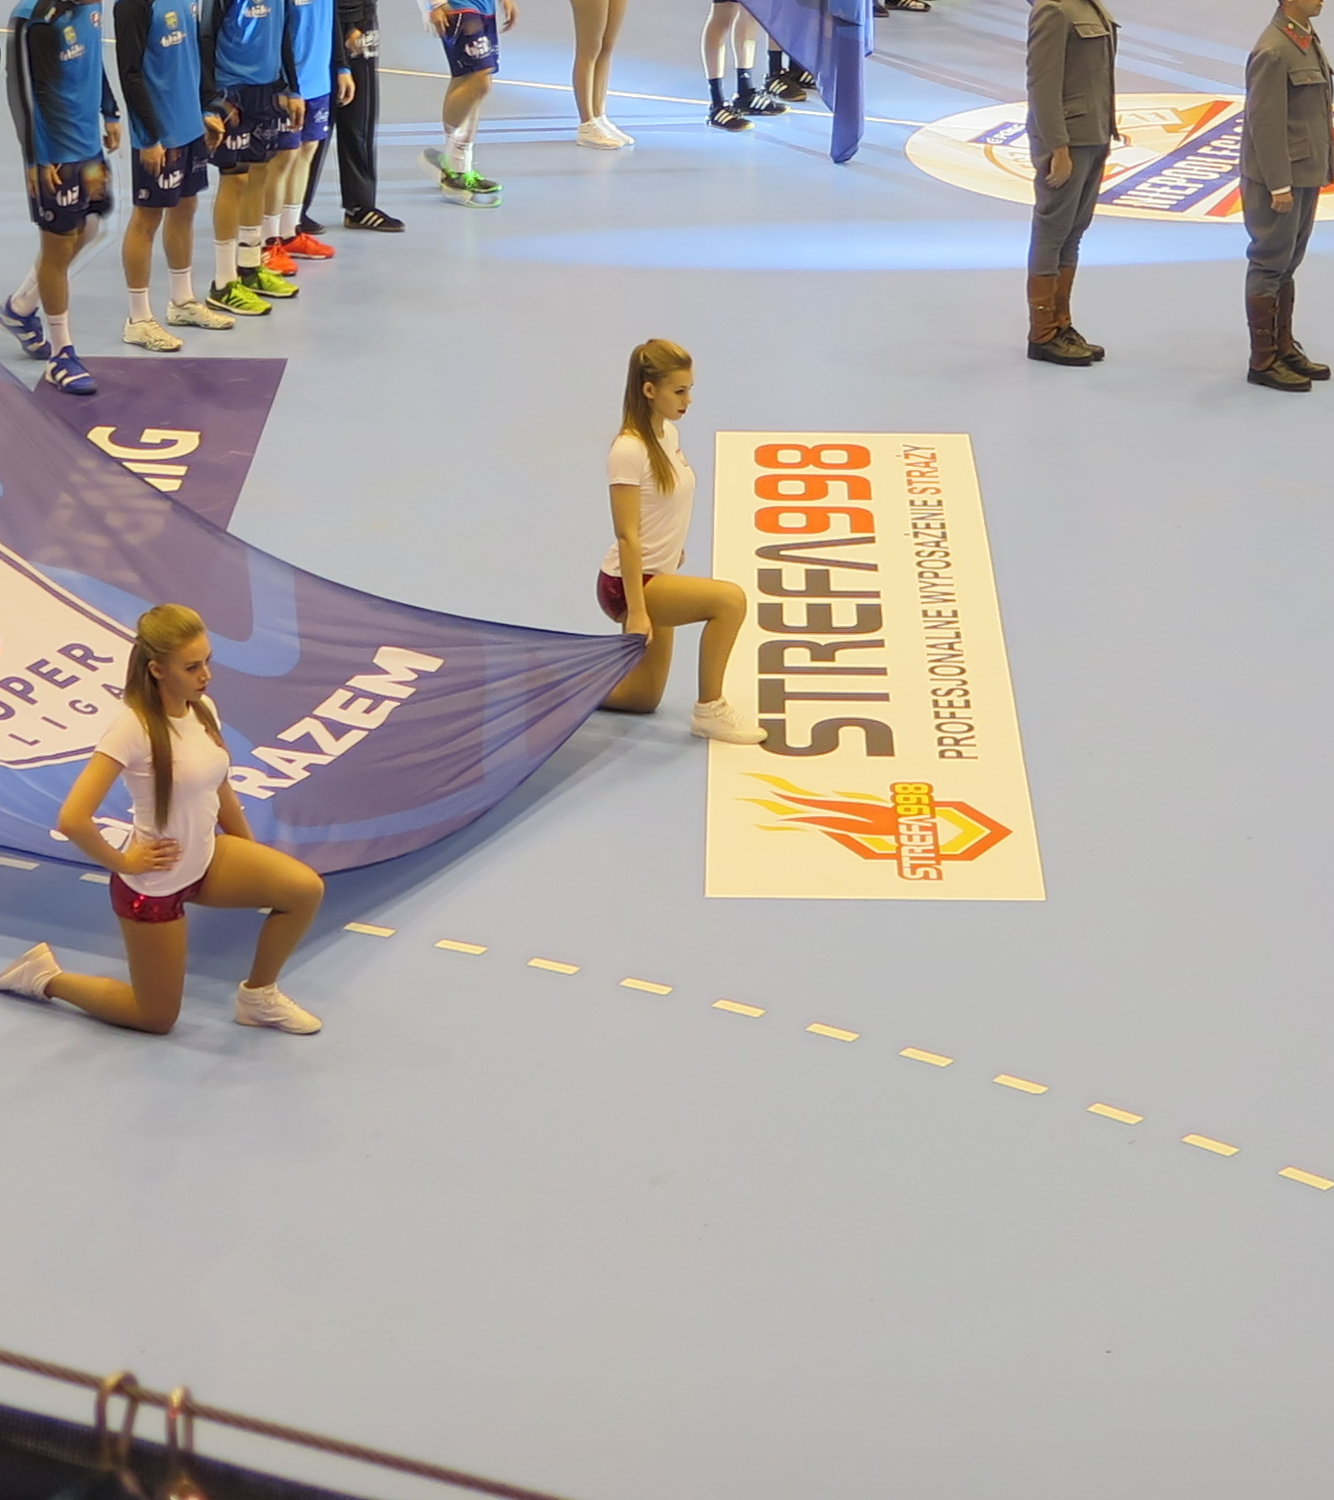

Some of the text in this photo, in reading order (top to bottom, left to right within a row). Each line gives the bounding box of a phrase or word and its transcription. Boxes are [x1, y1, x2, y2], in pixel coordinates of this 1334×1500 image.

[895, 443, 979, 761] PROFESJONALNE WYPOSAŻENIE STRAŻY
[7, 682, 126, 747] LIGA
